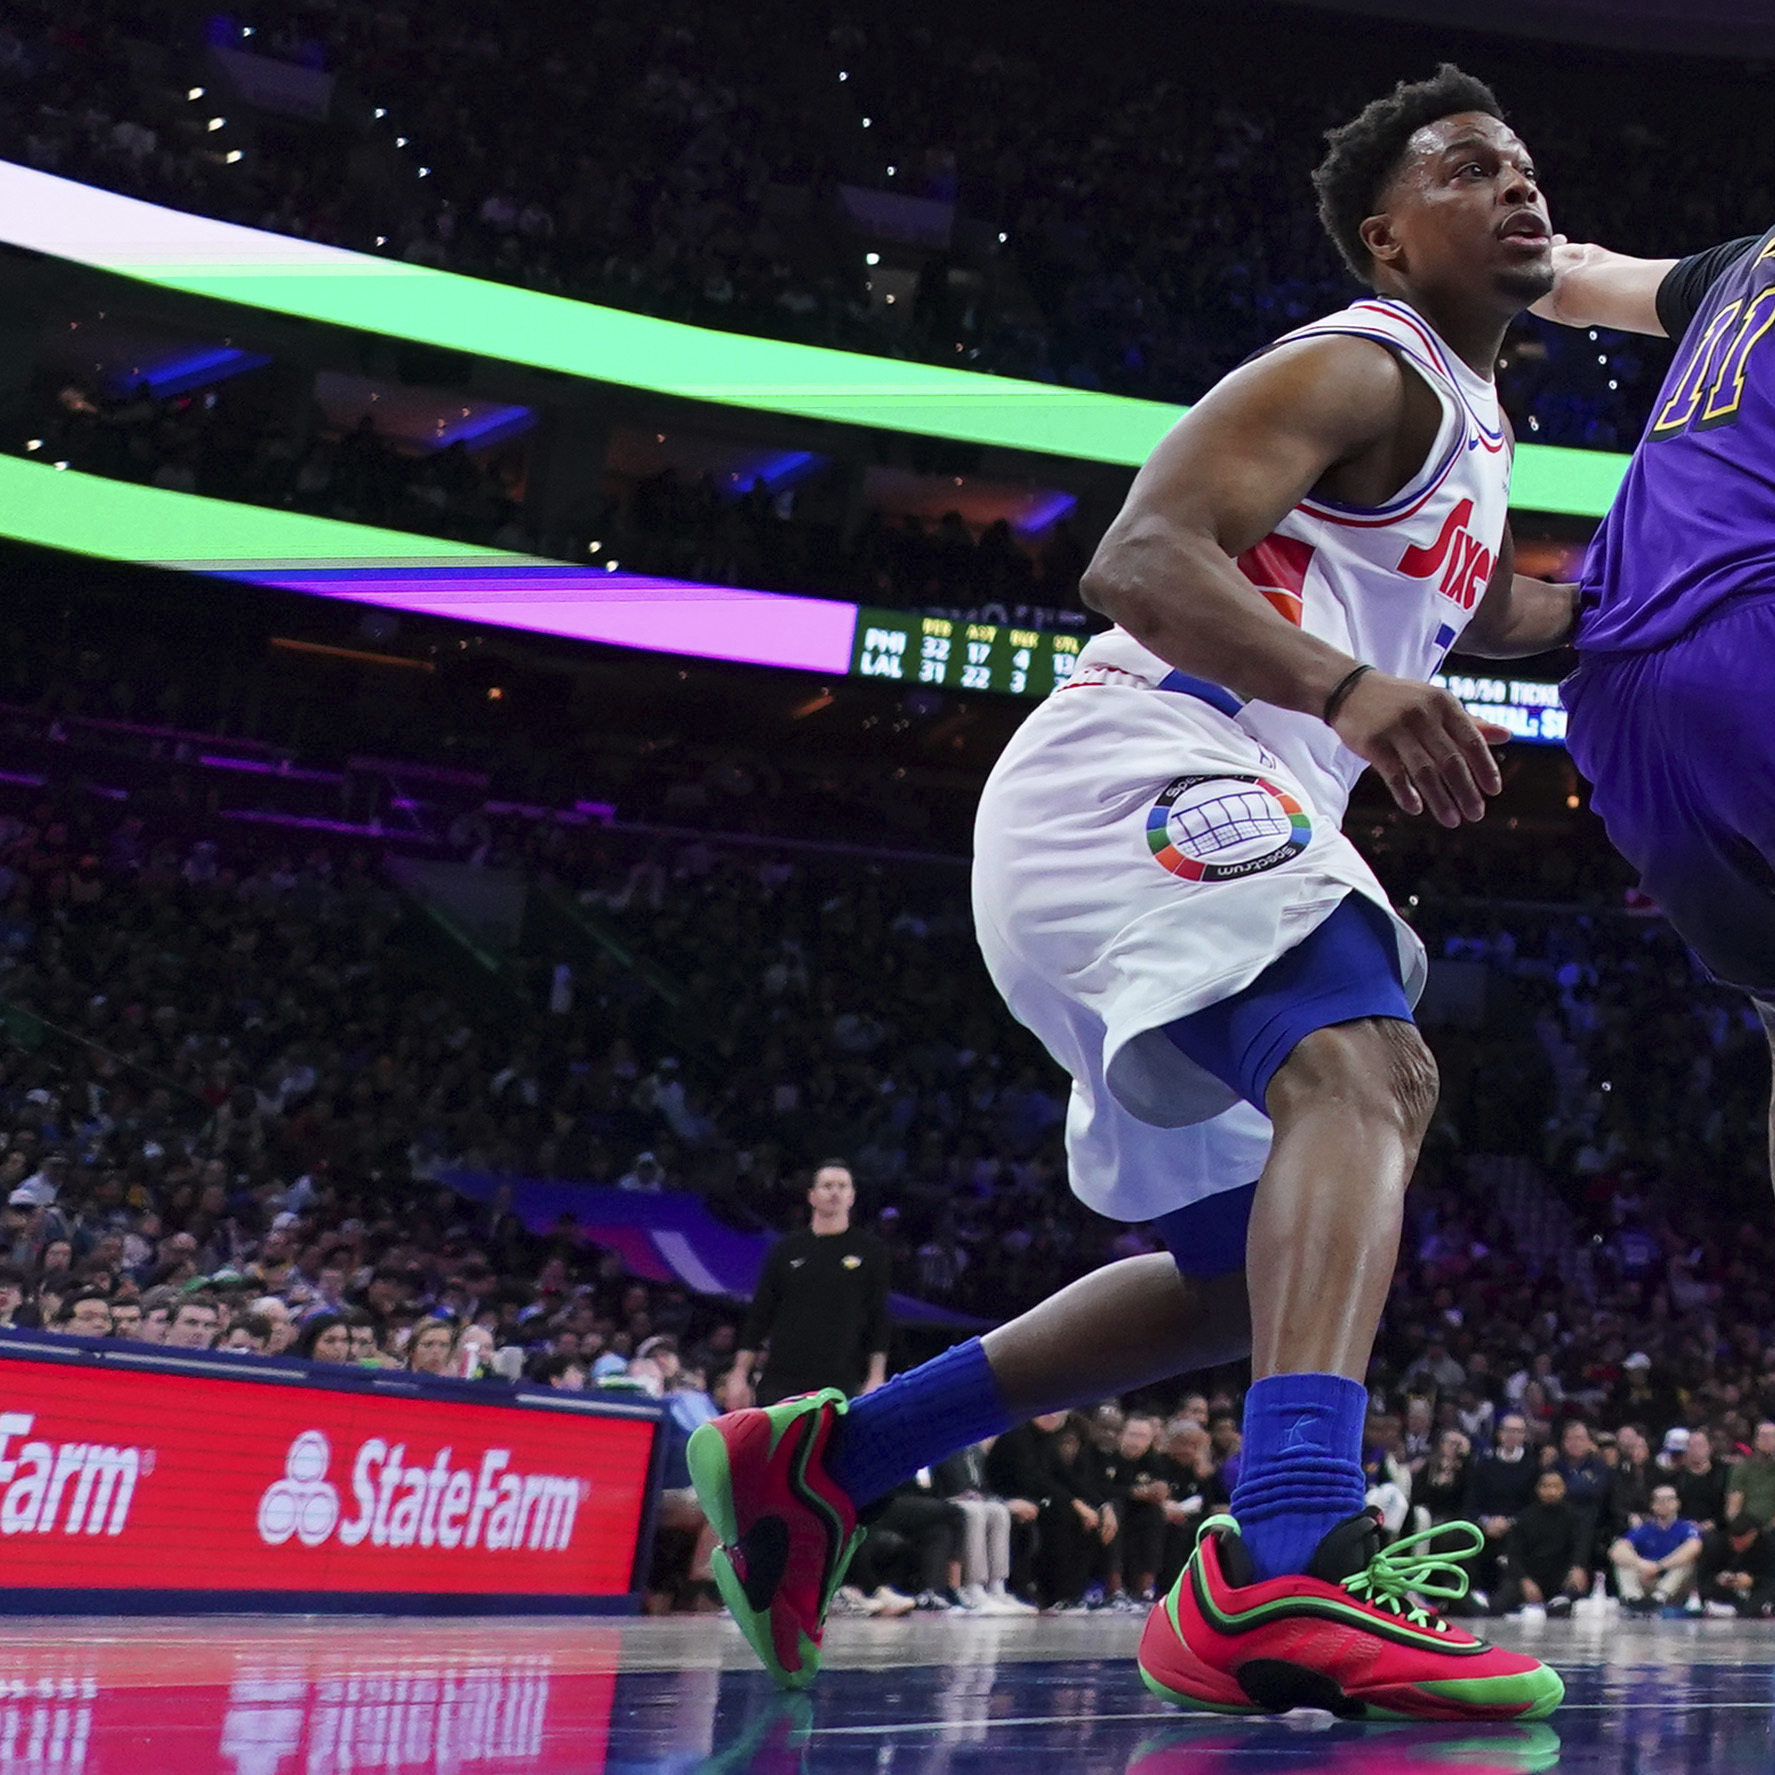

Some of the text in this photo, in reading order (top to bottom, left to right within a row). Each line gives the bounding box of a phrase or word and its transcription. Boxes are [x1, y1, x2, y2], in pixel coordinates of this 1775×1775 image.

[864, 626, 907, 656] PHI
[920, 635, 952, 661] 32
[966, 641, 991, 665] 17
[1012, 648, 1031, 672] 4
[860, 651, 1027, 694] LAL 31 22 3
[1217, 844, 1297, 877] Spectrum
